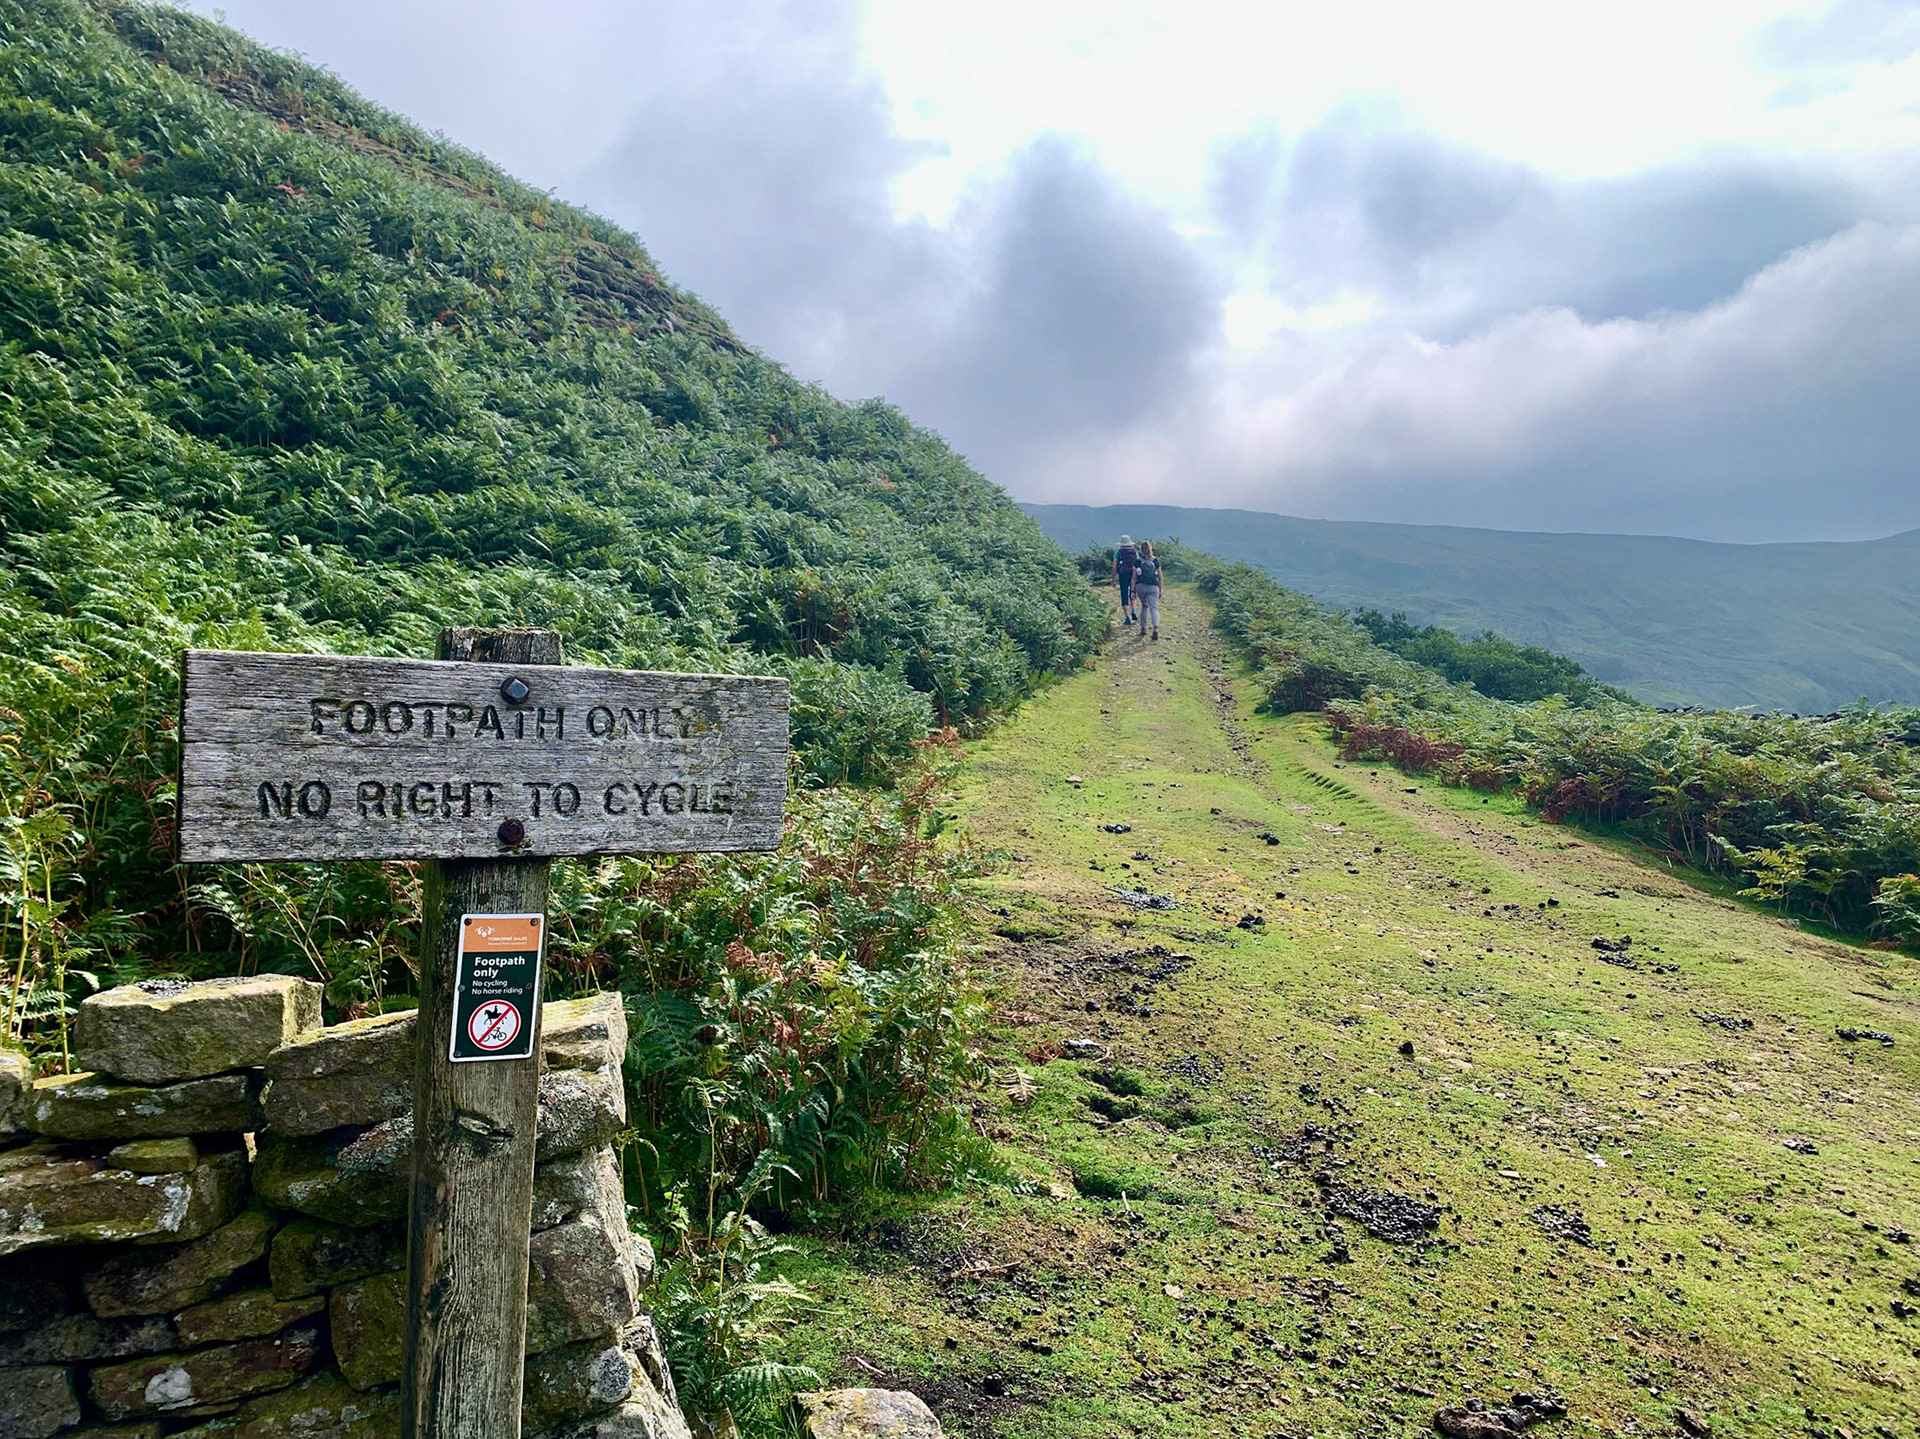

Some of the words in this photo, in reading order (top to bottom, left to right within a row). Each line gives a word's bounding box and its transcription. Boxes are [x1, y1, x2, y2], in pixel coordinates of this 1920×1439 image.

[310, 698, 564, 740] FOOTPATH
[586, 705, 695, 740] ONLY
[257, 780, 332, 820] NO
[357, 780, 504, 820] RIGHT
[523, 780, 581, 818] TO
[603, 780, 735, 818] CYCLE
[474, 956, 525, 968] Footpath
[474, 967, 498, 978] only
